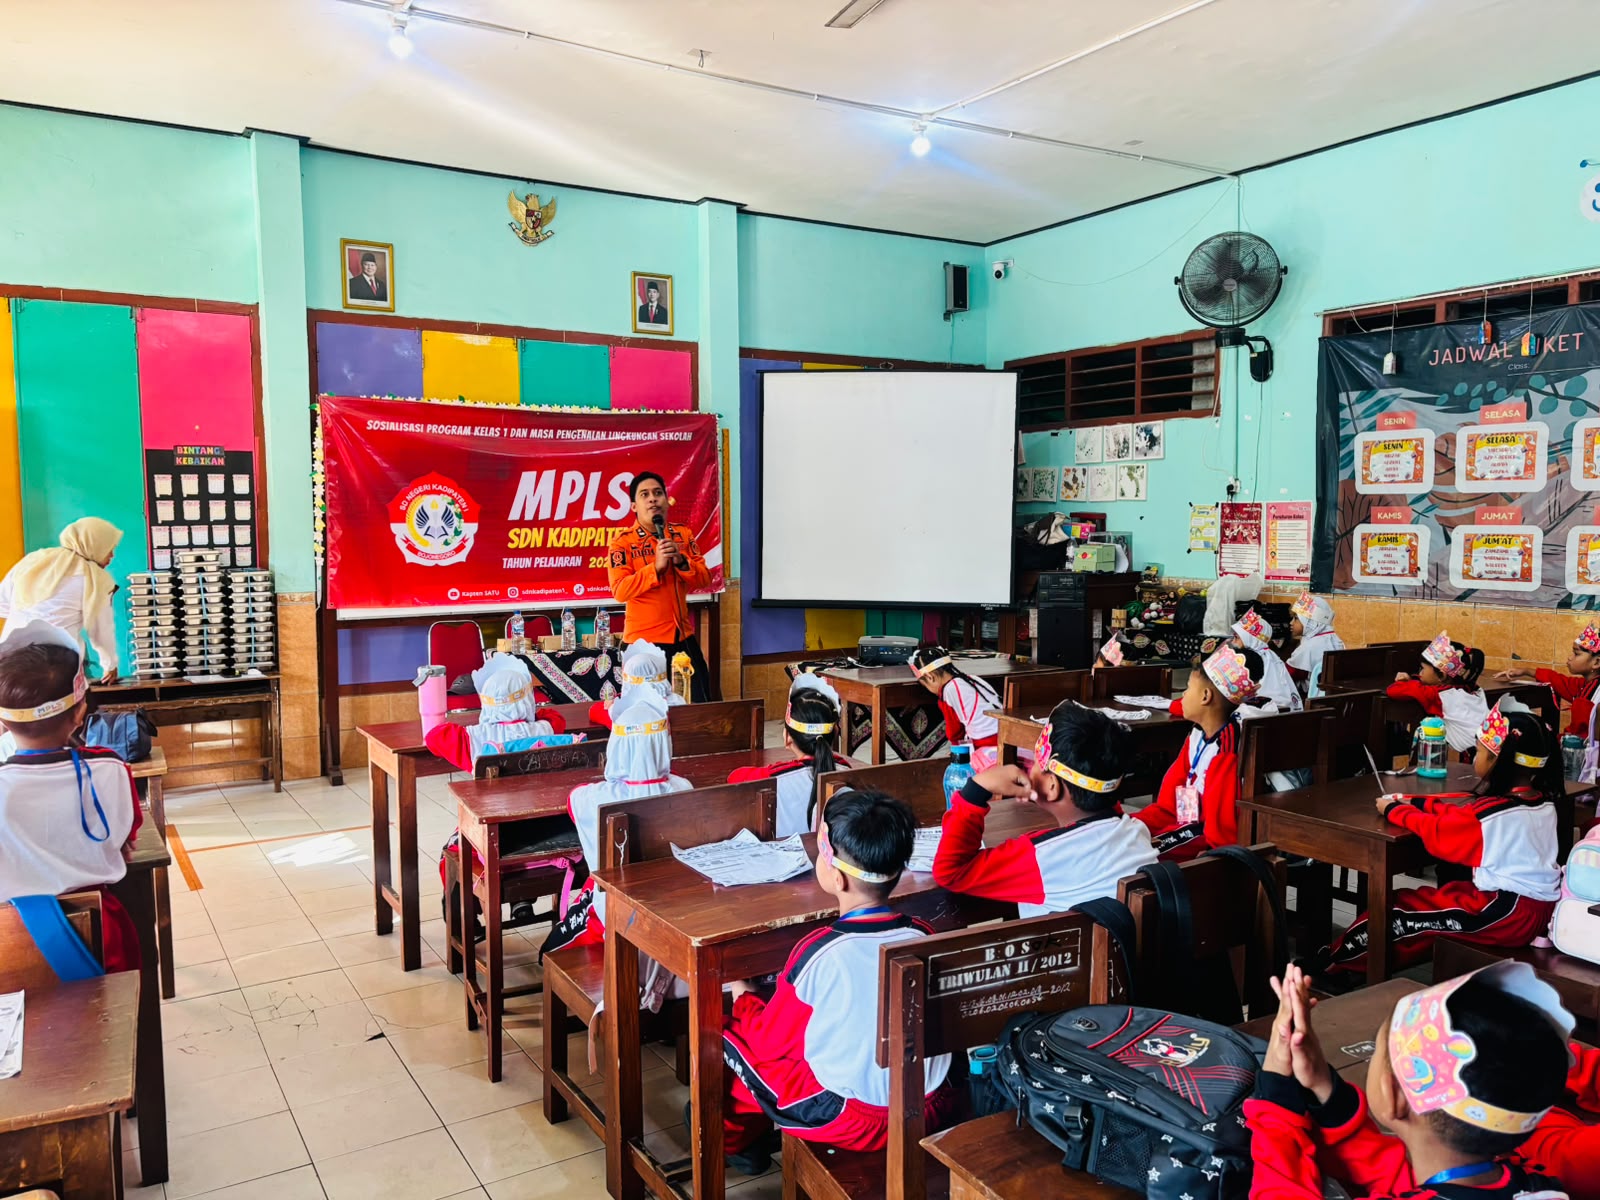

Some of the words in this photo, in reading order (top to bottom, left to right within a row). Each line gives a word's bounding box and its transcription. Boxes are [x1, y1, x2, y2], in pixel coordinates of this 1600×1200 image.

[1429, 342, 1513, 366] JADWAL
[1485, 409, 1521, 419] SELASA
[1384, 417, 1406, 426] SENIN
[366, 420, 424, 433] SOSIALISASI
[426, 424, 471, 436] PROGRAM
[473, 426, 500, 437] KELAS
[503, 428, 508, 437] 1
[510, 428, 528, 438] DAN
[529, 428, 554, 439] MASA
[556, 429, 606, 440] PENGENALAN
[608, 431, 658, 441] LINGKUNGAN
[660, 432, 693, 441] SEKOLAH
[1486, 436, 1516, 444] SELASA
[176, 446, 221, 455] BINTANG
[176, 457, 225, 466] KEBAIKAN
[406, 484, 430, 502] NEGERI
[432, 483, 468, 510] KADIPATEN
[507, 469, 635, 521] MPLS
[1378, 512, 1402, 520] KAMIS
[1481, 512, 1516, 520] JUMAT
[507, 527, 544, 549] SDN
[502, 558, 532, 568] TAHUN
[534, 556, 582, 568] PELAJARAN
[938, 964, 1011, 991] TRIWULAN
